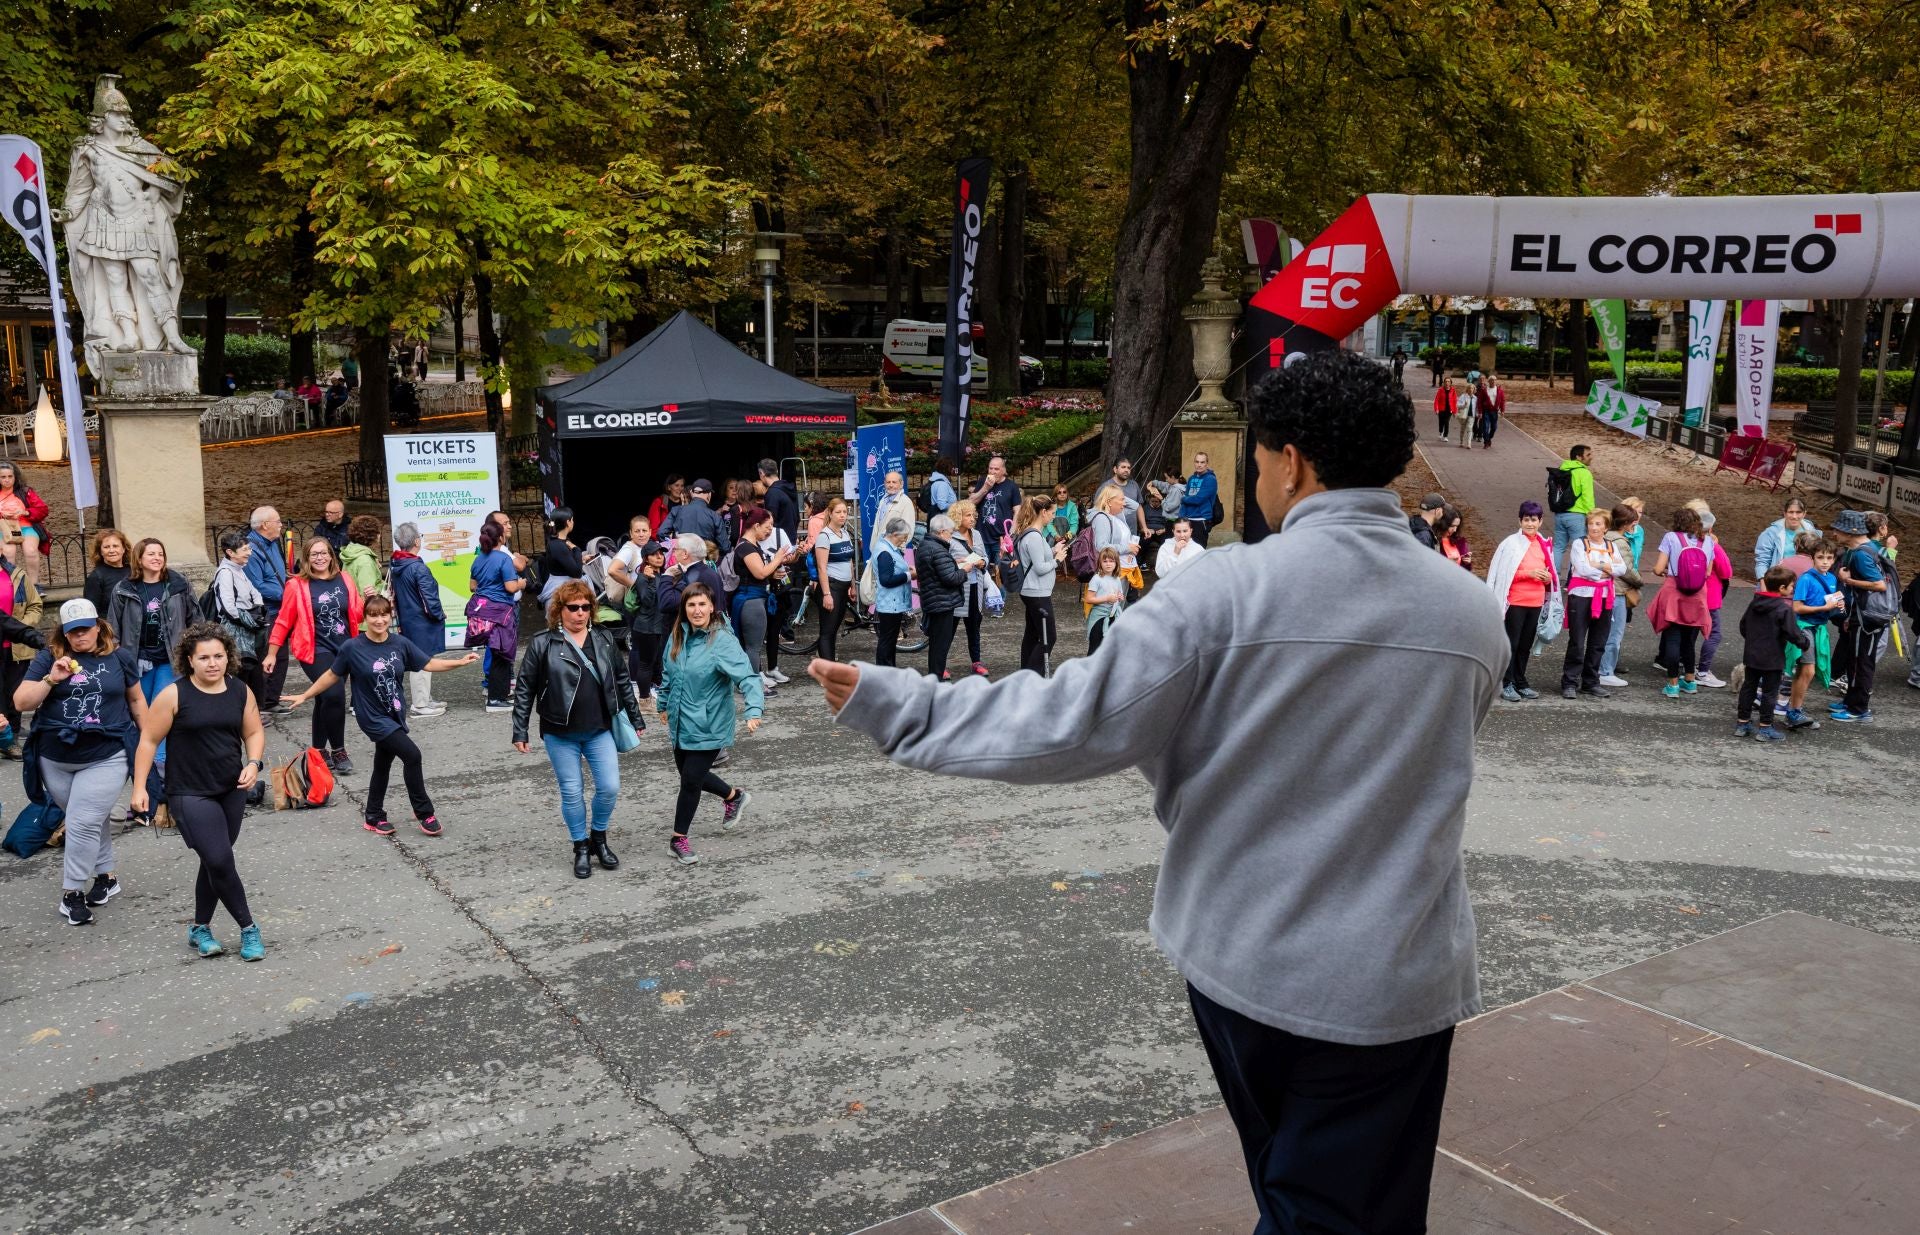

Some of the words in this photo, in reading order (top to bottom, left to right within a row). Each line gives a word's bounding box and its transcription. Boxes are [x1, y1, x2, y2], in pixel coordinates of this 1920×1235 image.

[1510, 234, 1577, 272] EL
[1588, 233, 1837, 274] CORREO
[1300, 277, 1362, 309] EC
[567, 414, 592, 430] EL
[593, 411, 672, 428] CORREO
[745, 413, 847, 423] www.elcorreo.com
[405, 439, 476, 455] TICKETS
[407, 458, 432, 466] Venta
[437, 457, 476, 465] Salmenta
[1798, 461, 1806, 473] EL
[1806, 463, 1831, 481] CORREO
[1845, 474, 1853, 486] EL
[1853, 476, 1881, 495] CORREO
[430, 490, 472, 499] MARCHA
[1896, 486, 1903, 500] EL
[403, 499, 454, 508] SOLIDARIA
[455, 497, 486, 505] GREEN
[417, 510, 429, 518] por
[431, 508, 439, 516] el
